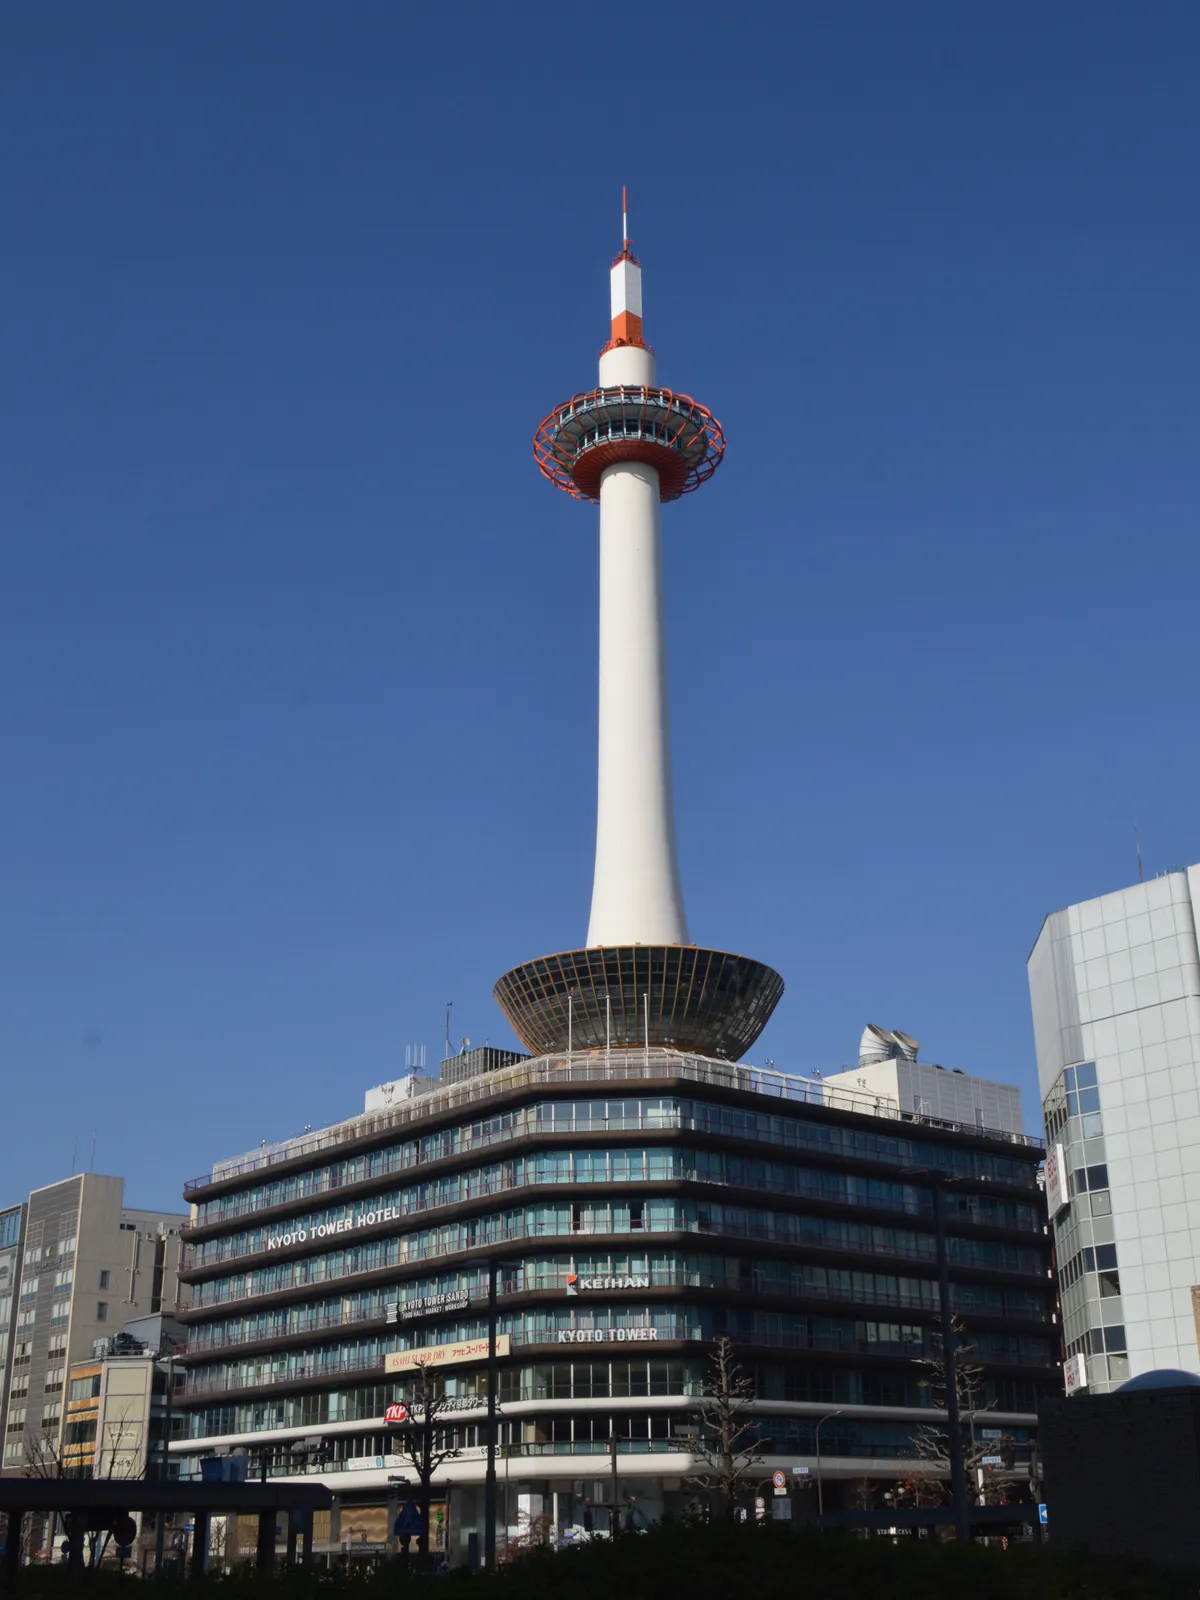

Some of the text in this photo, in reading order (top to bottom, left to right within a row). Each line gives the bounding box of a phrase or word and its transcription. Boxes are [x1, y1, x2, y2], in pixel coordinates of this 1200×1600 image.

[267, 1206, 400, 1250] KYOTO TOWER HOTEL
[580, 1277, 649, 1289] KEIHAN
[403, 1289, 469, 1311] KYOTO TOWER SANDO
[558, 1327, 658, 1343] KYOTO TOWER
[452, 1340, 501, 1357] アサヒスーパードイ
[392, 1348, 448, 1367] ASAHI SUPER DRY
[386, 1405, 406, 1419] TKP
